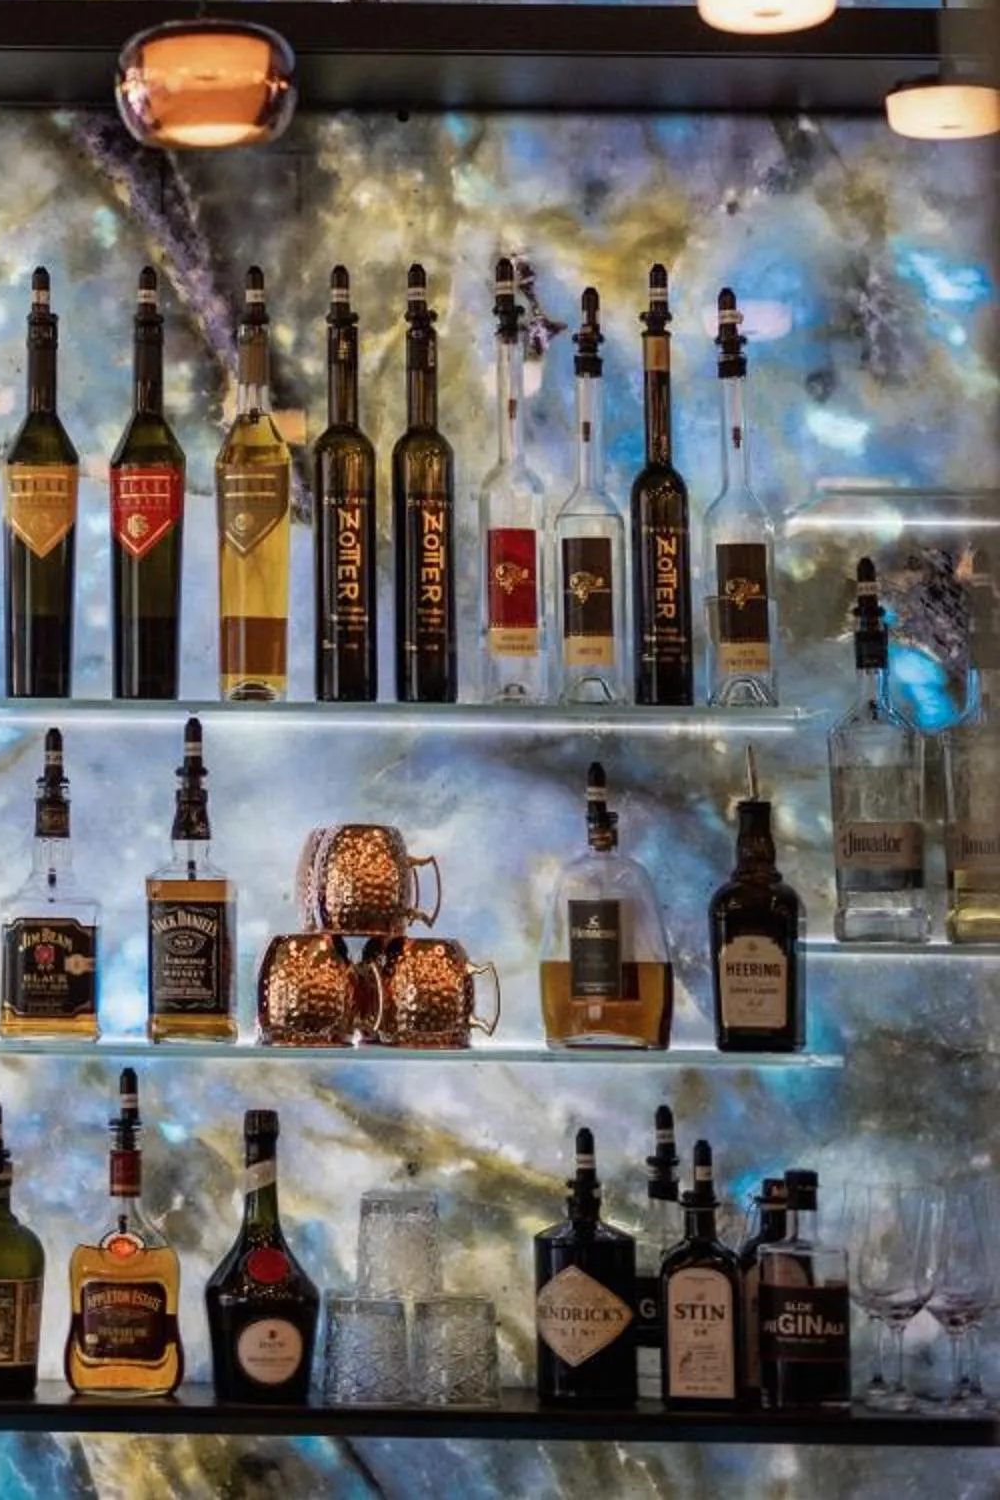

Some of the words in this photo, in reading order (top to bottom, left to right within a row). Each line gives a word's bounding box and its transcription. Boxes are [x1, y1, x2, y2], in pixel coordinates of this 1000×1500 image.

[338, 508, 361, 600] ZOTTER
[421, 511, 444, 602] ZOTTER
[656, 536, 677, 619] ZOTTER
[152, 913, 177, 934] JACK
[21, 931, 40, 950] JIM
[726, 963, 781, 977] HEERING
[674, 1303, 726, 1321] STIN
